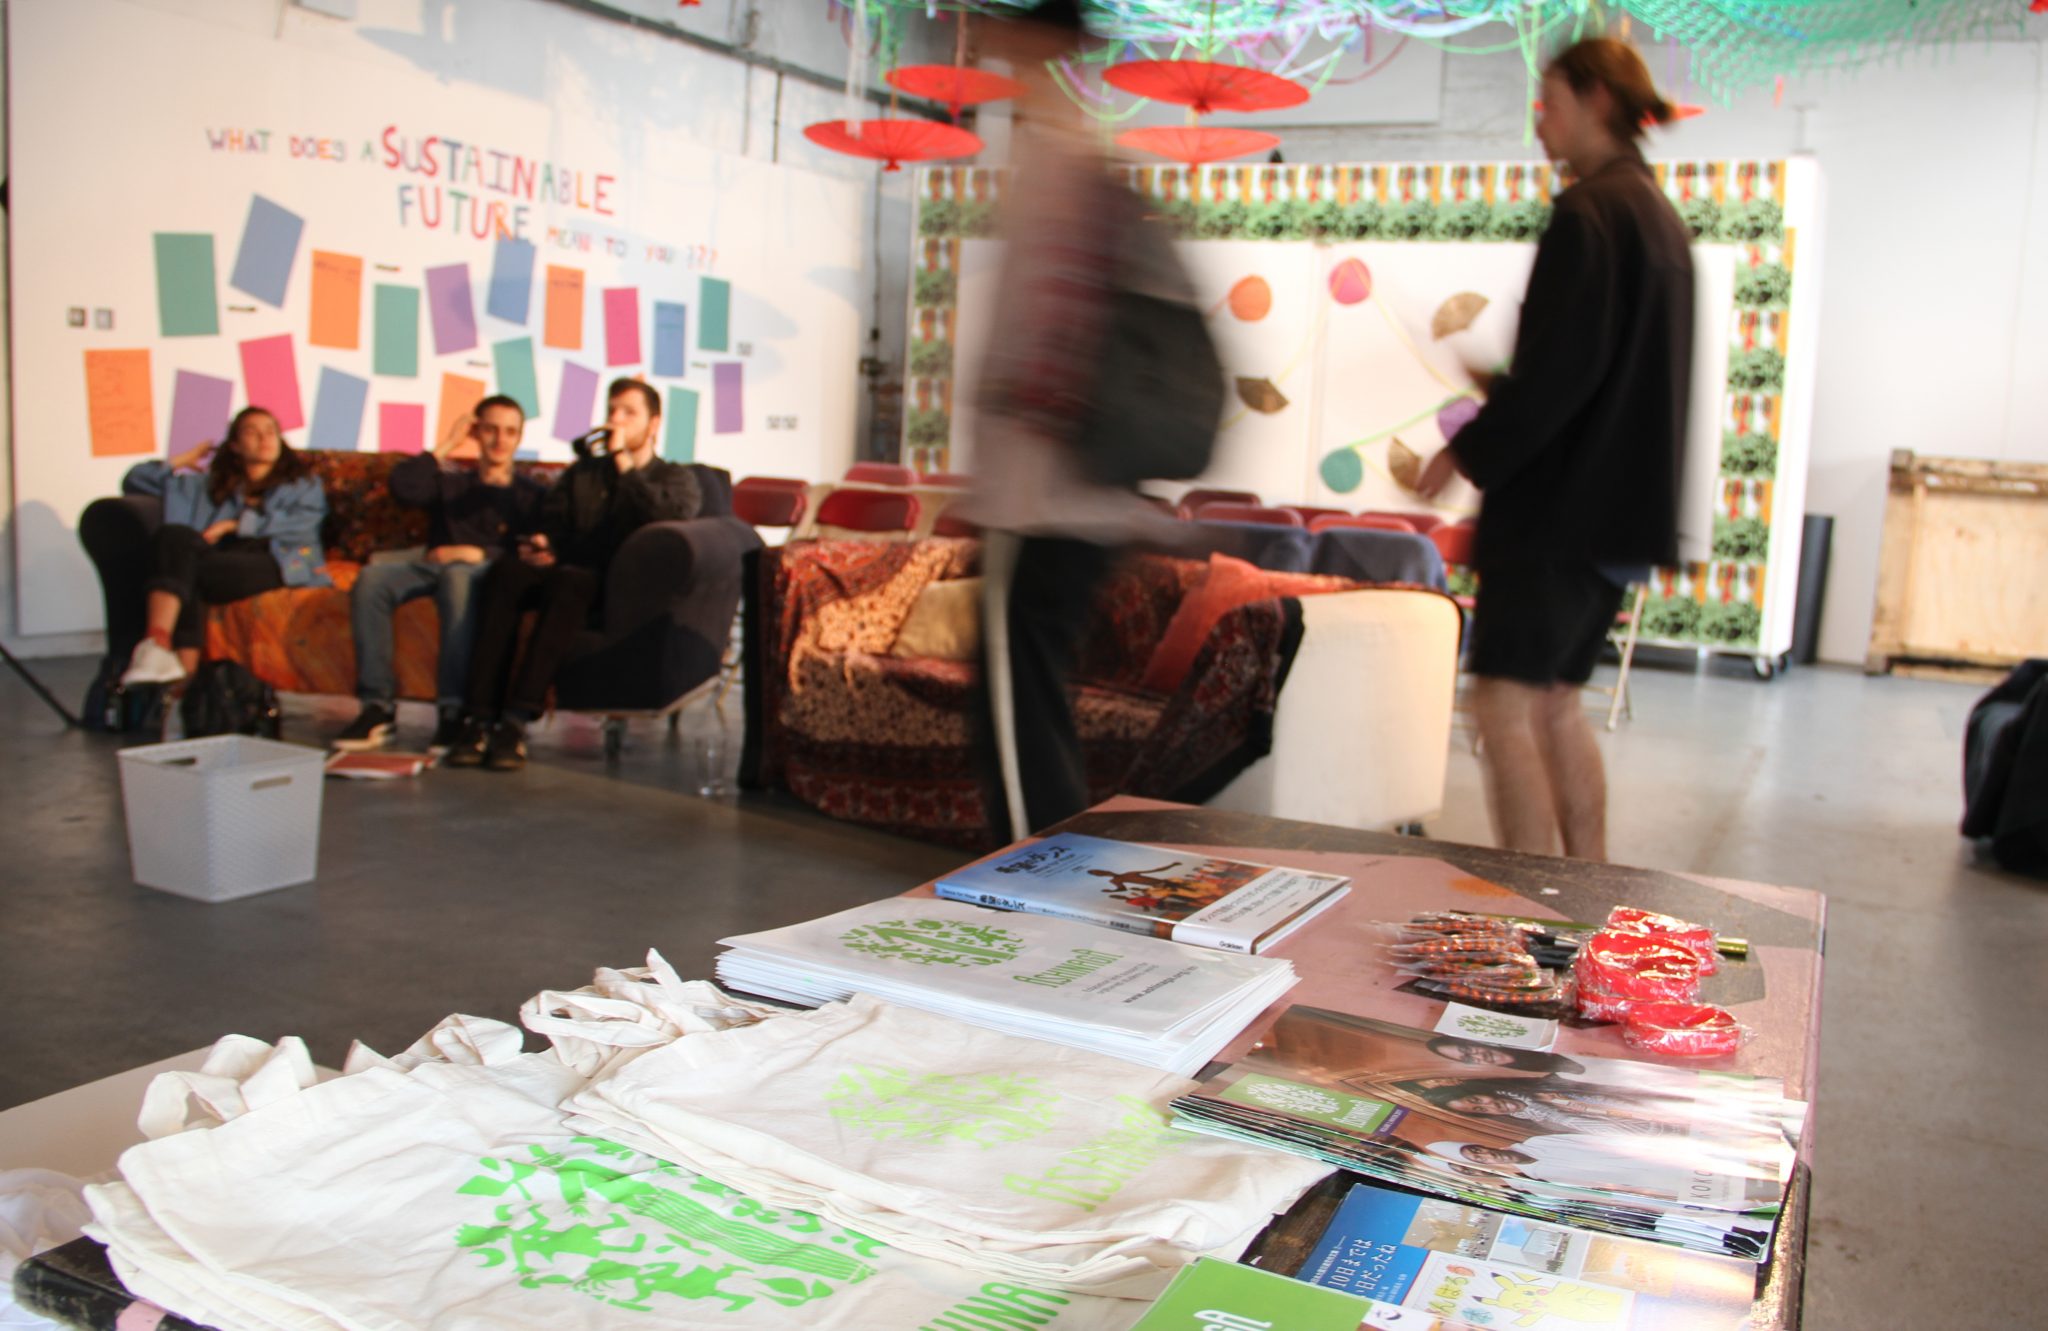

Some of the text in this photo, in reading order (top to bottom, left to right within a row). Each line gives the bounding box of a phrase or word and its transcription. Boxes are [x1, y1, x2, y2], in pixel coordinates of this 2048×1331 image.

[205, 125, 616, 216] WHAT DOES A SUSTAINABLE
[399, 184, 529, 240] FUTURE
[605, 236, 626, 258] TO
[1219, 940, 1244, 951] Gakken
